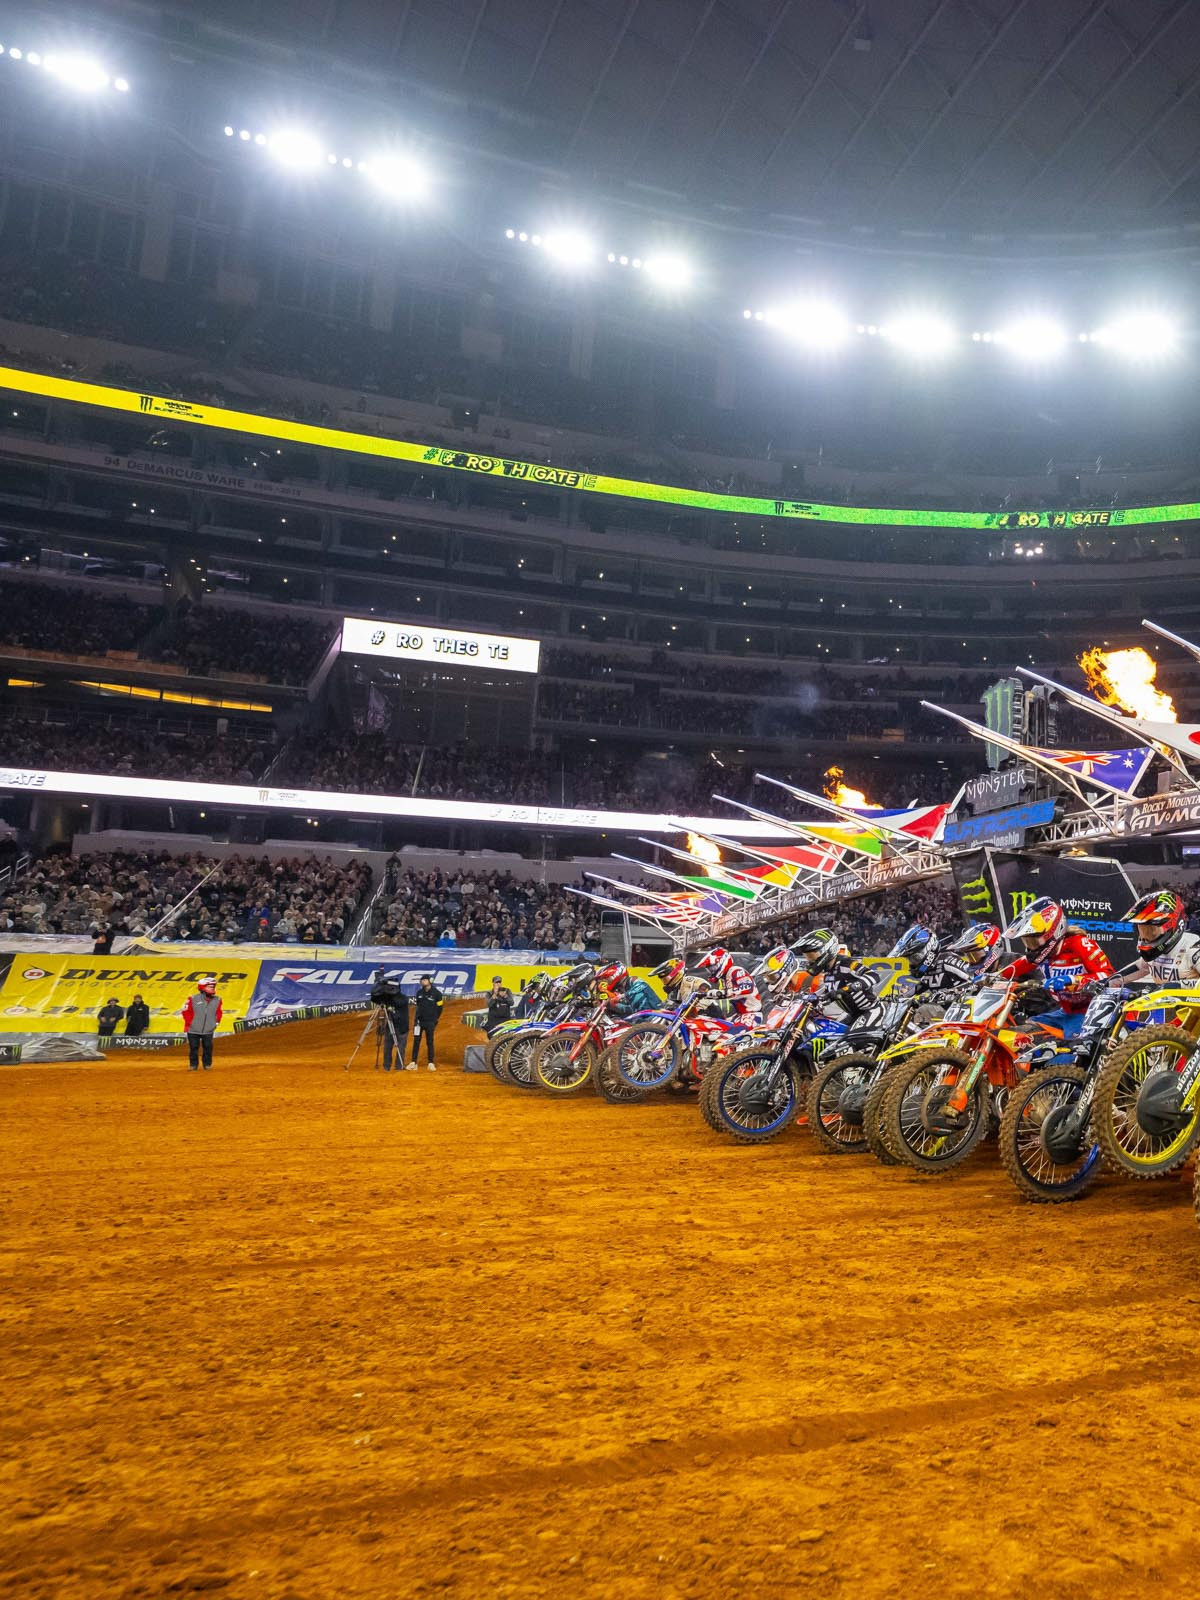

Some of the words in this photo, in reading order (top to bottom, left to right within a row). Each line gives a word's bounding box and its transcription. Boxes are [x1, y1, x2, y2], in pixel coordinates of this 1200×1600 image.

[104, 456, 120, 467] 94
[207, 473, 245, 488] WARE
[534, 468, 579, 486] GATE
[1072, 512, 1109, 525] GATE
[397, 633, 422, 649] RO
[433, 637, 478, 656] THEG
[488, 644, 509, 660] TE
[966, 769, 1026, 799] MONSTER
[1142, 801, 1166, 815] ROCKY
[1060, 898, 1112, 912] MONSTER
[60, 968, 248, 983] DUNLOP
[324, 1002, 366, 1014] MONSTER
[248, 1012, 292, 1028] MONSTER
[116, 1037, 168, 1046] MONSTER
